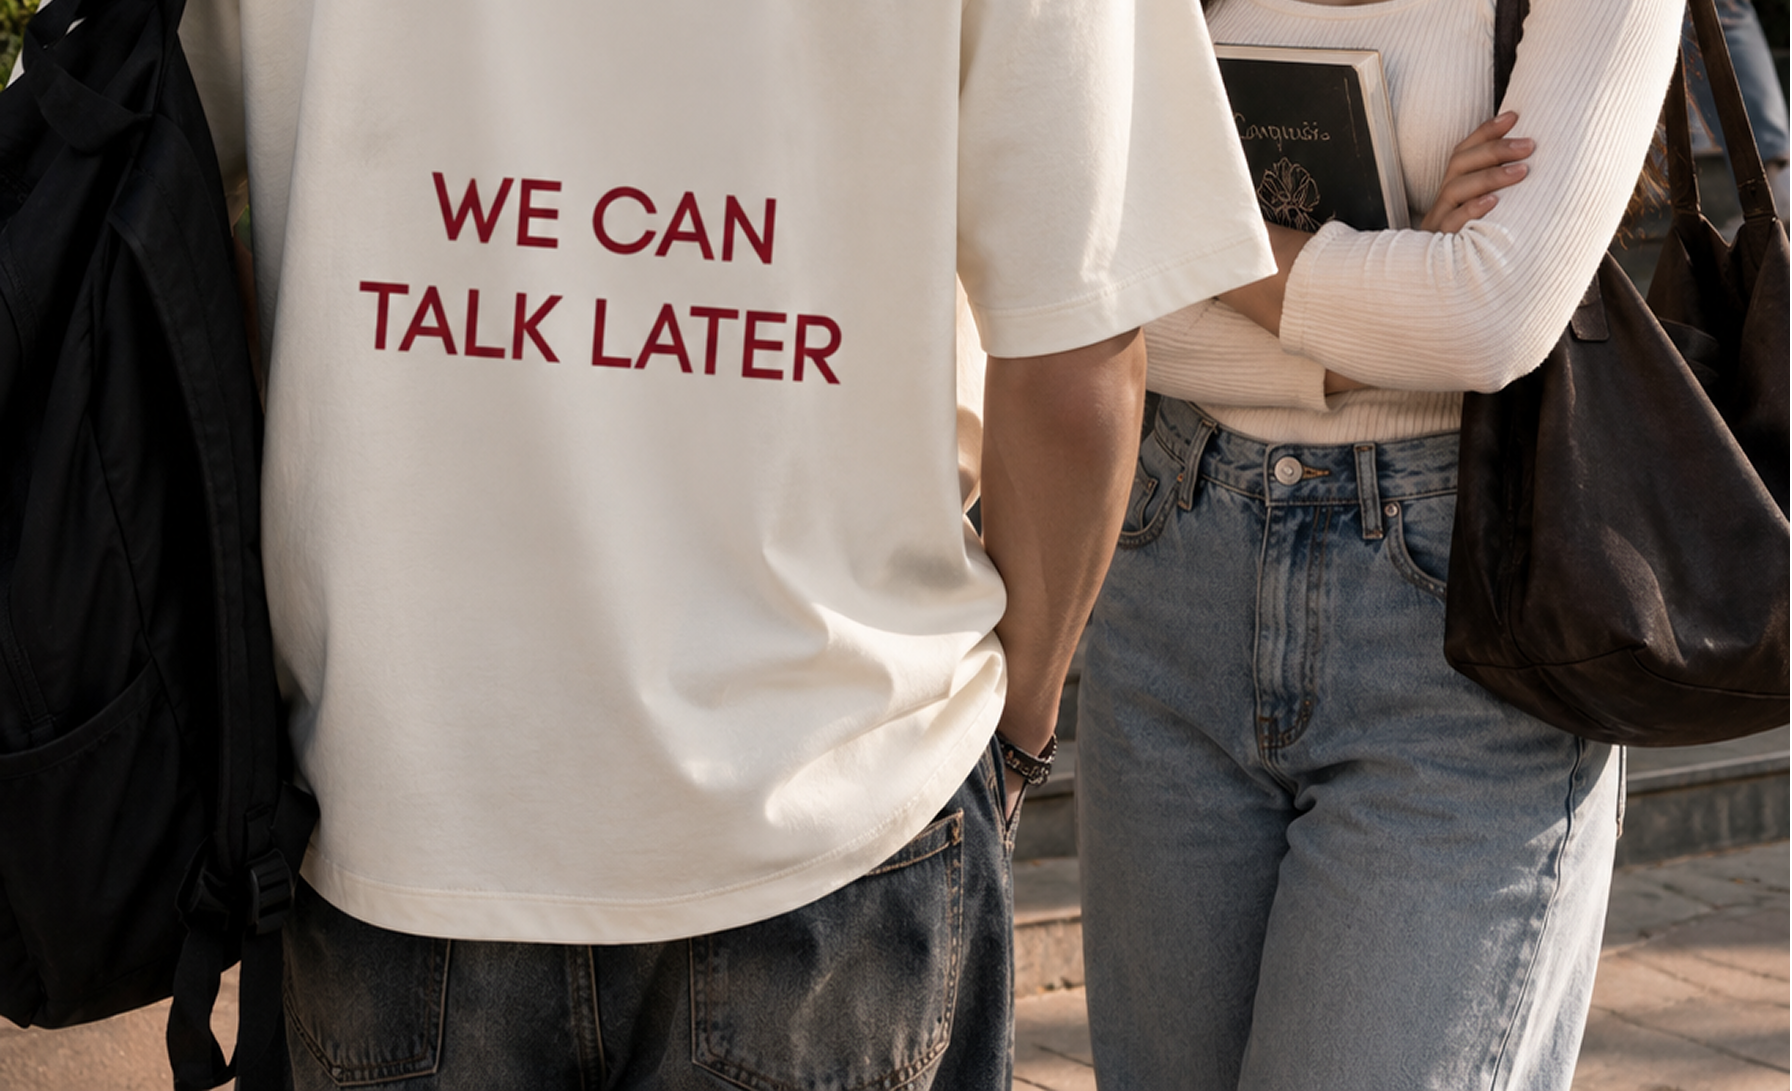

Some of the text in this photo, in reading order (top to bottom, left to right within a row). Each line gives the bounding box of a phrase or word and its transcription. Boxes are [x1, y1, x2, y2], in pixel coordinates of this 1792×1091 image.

[432, 172, 776, 265] WE CAN
[359, 281, 842, 384] TALK LATER
